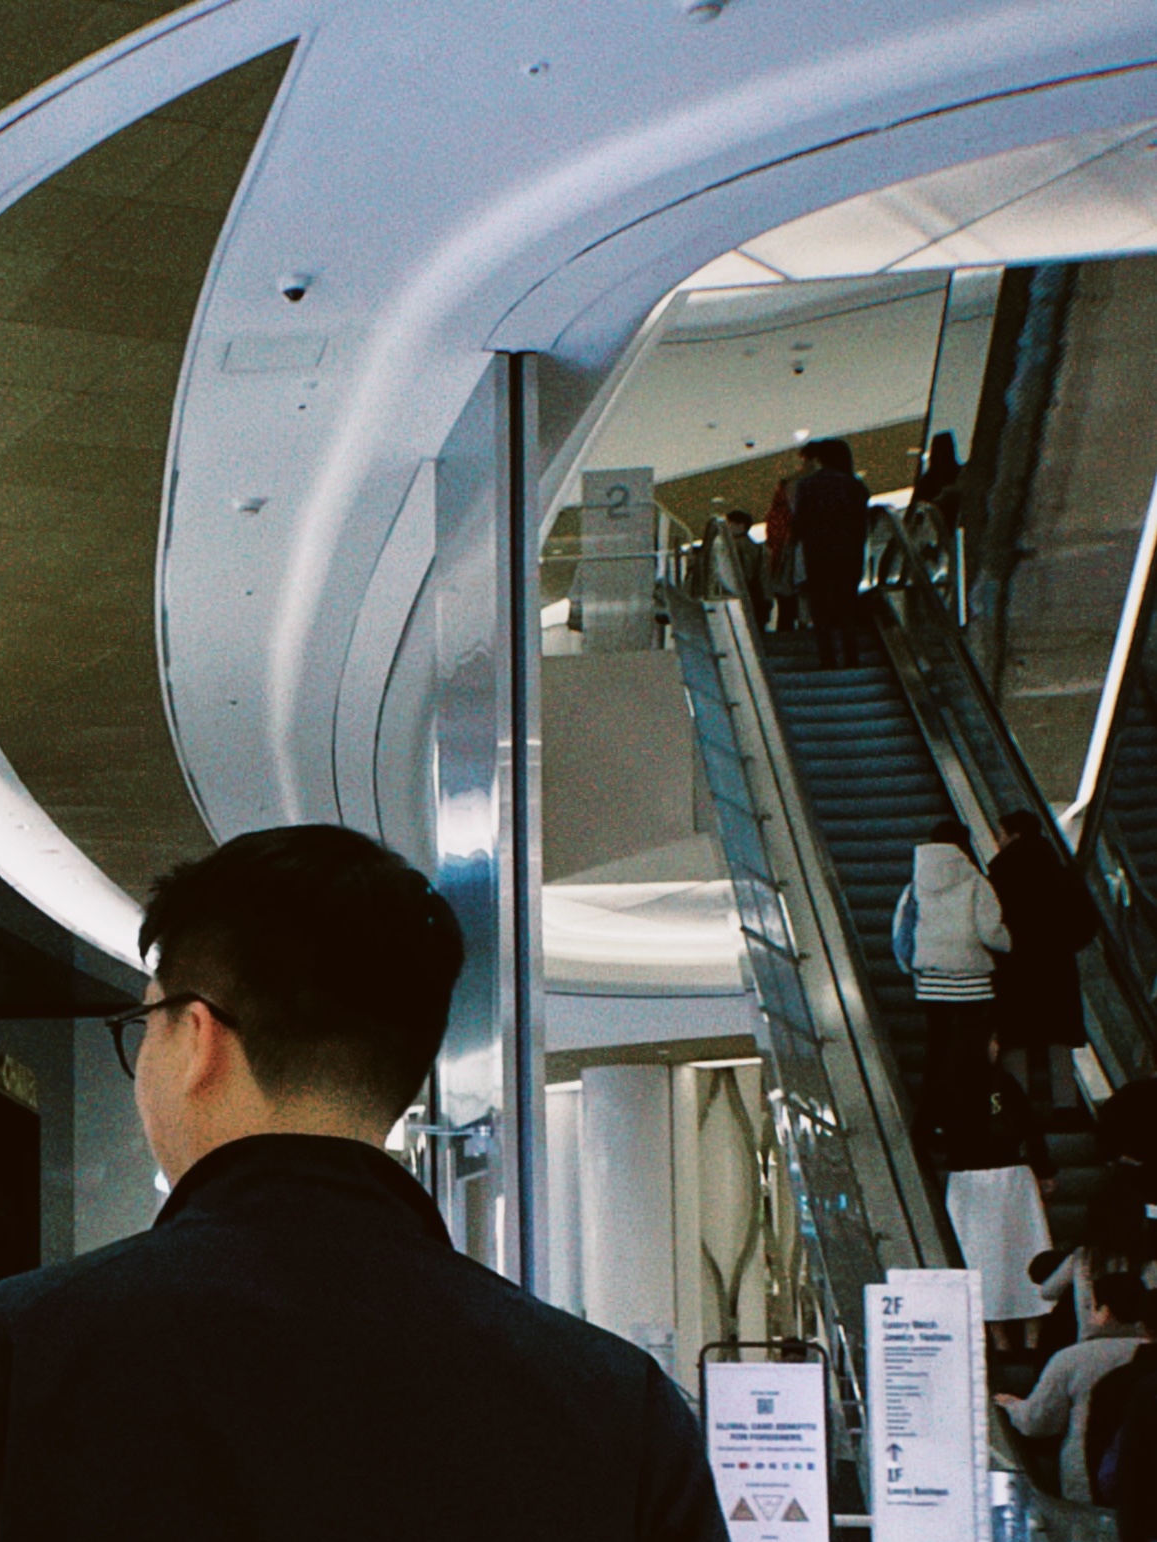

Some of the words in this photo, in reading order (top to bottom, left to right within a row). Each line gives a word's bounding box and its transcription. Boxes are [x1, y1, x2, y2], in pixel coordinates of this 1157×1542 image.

[606, 483, 631, 519] 2
[881, 1295, 904, 1315] 2F
[887, 1467, 903, 1482] 1F
